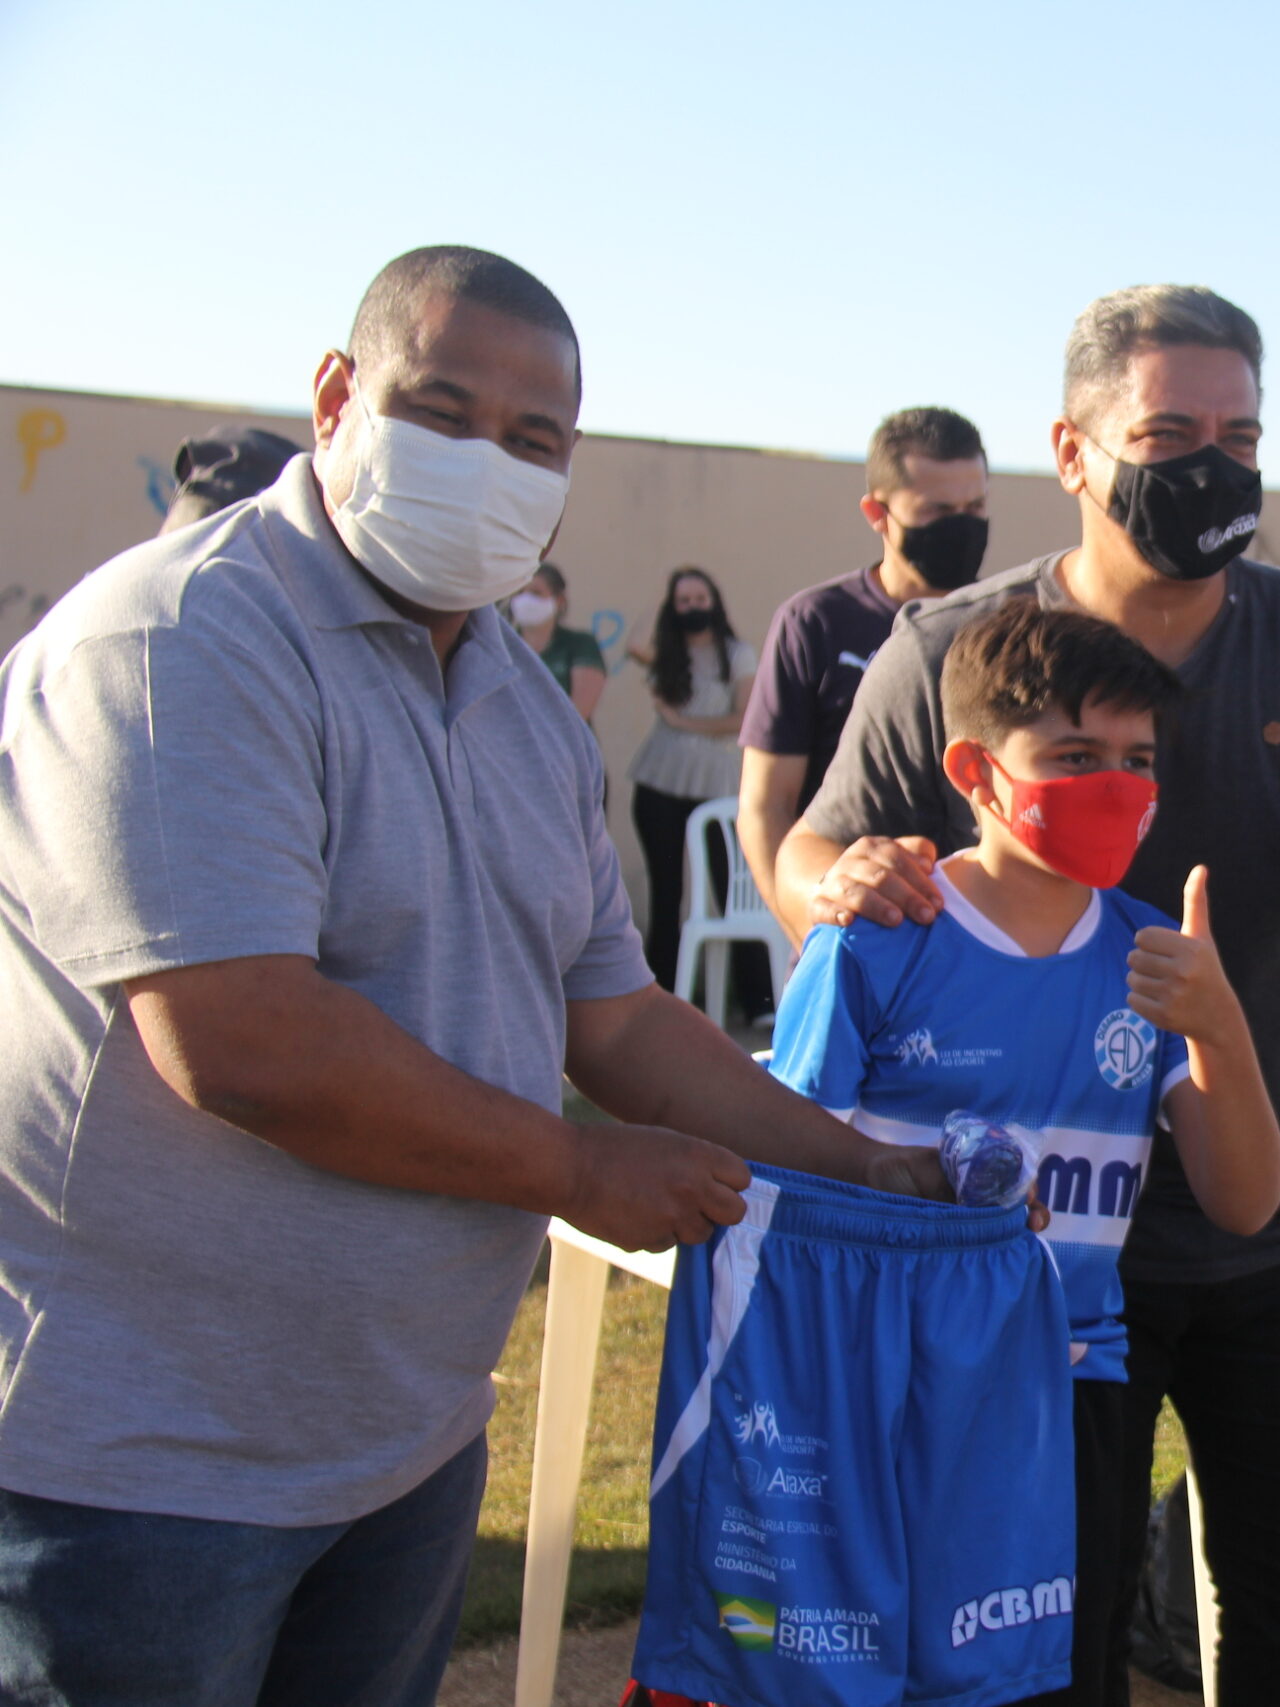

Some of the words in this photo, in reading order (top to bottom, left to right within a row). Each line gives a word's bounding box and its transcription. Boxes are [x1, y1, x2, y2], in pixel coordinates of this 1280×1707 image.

[714, 1555, 777, 1582] CIDADANIA
[780, 1604, 821, 1624] PÁTRIA
[824, 1608, 880, 1626] AMADA
[778, 1622, 879, 1653] BRASIL
